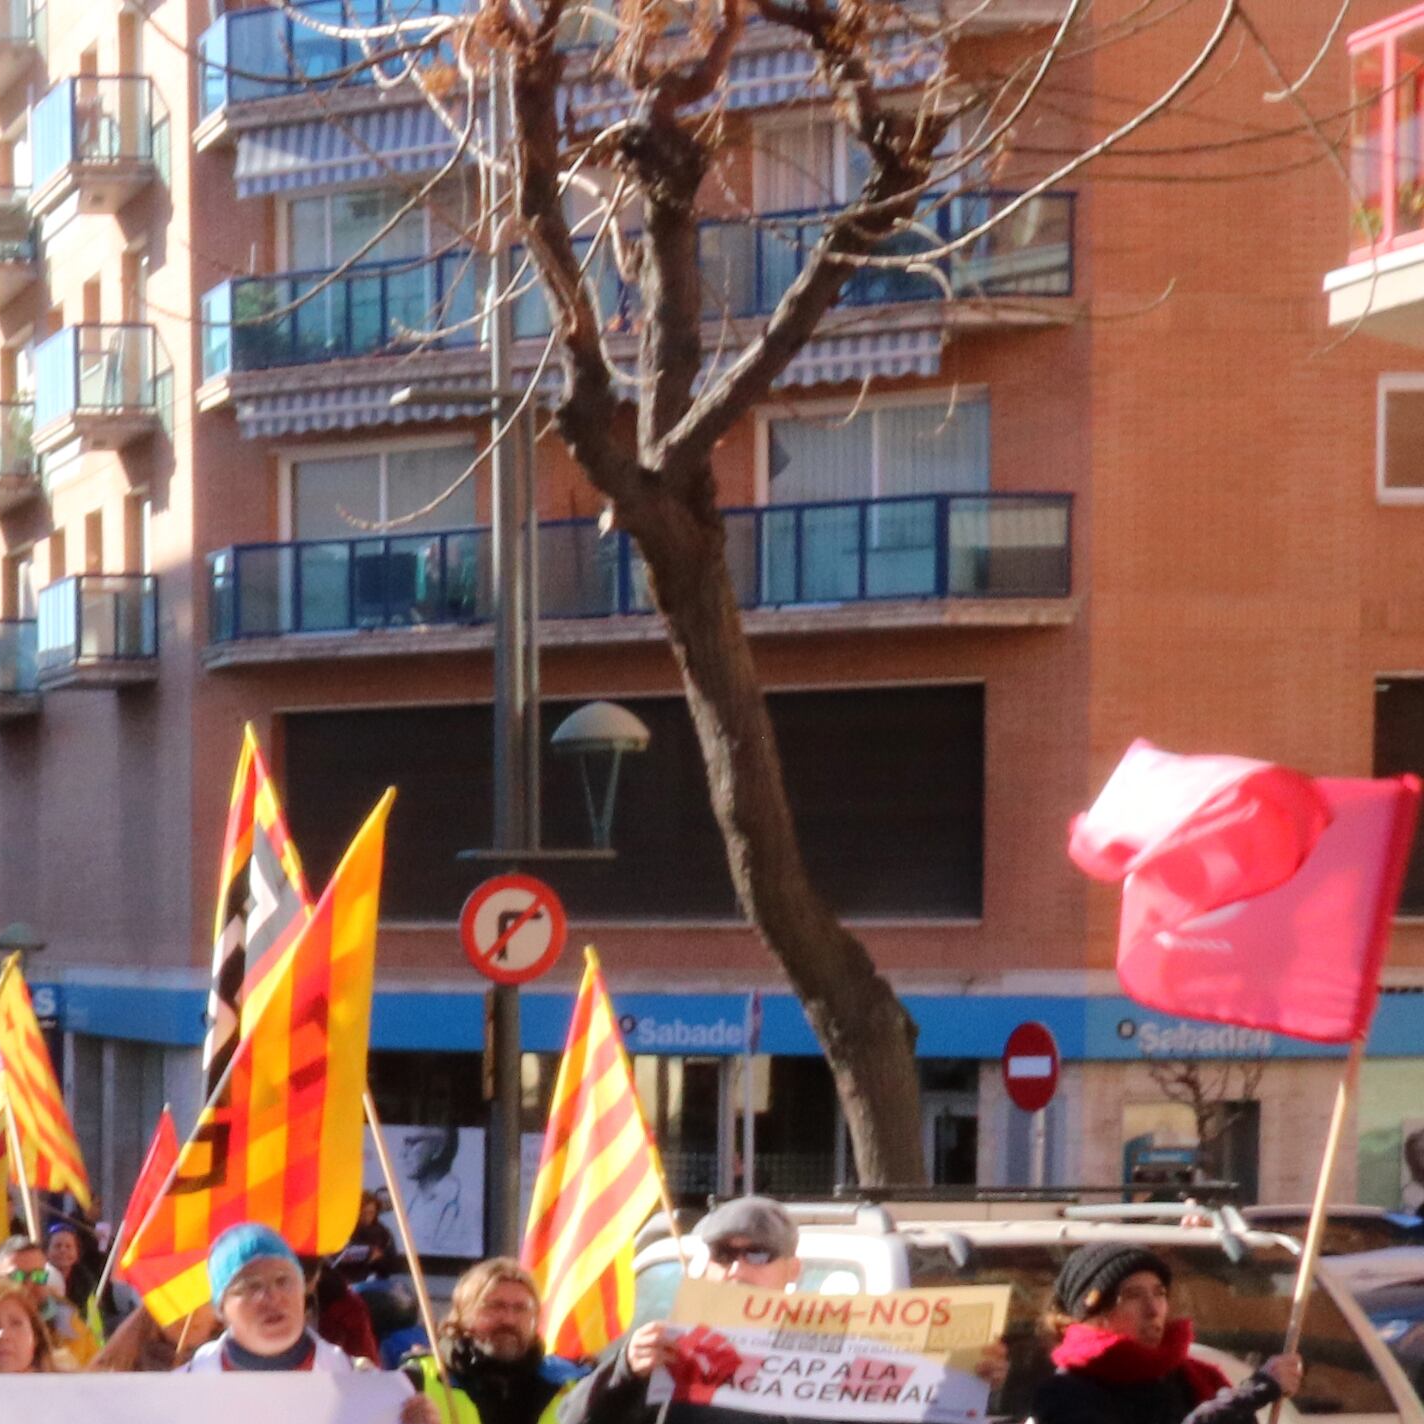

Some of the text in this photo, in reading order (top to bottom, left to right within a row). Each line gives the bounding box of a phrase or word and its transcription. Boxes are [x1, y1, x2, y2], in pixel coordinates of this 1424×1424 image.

[637, 1017, 746, 1046] Sabade
[742, 1296, 953, 1327] UNIM-NOS
[761, 1355, 899, 1381] CAP A LA
[794, 1380, 939, 1405] GENERAL
